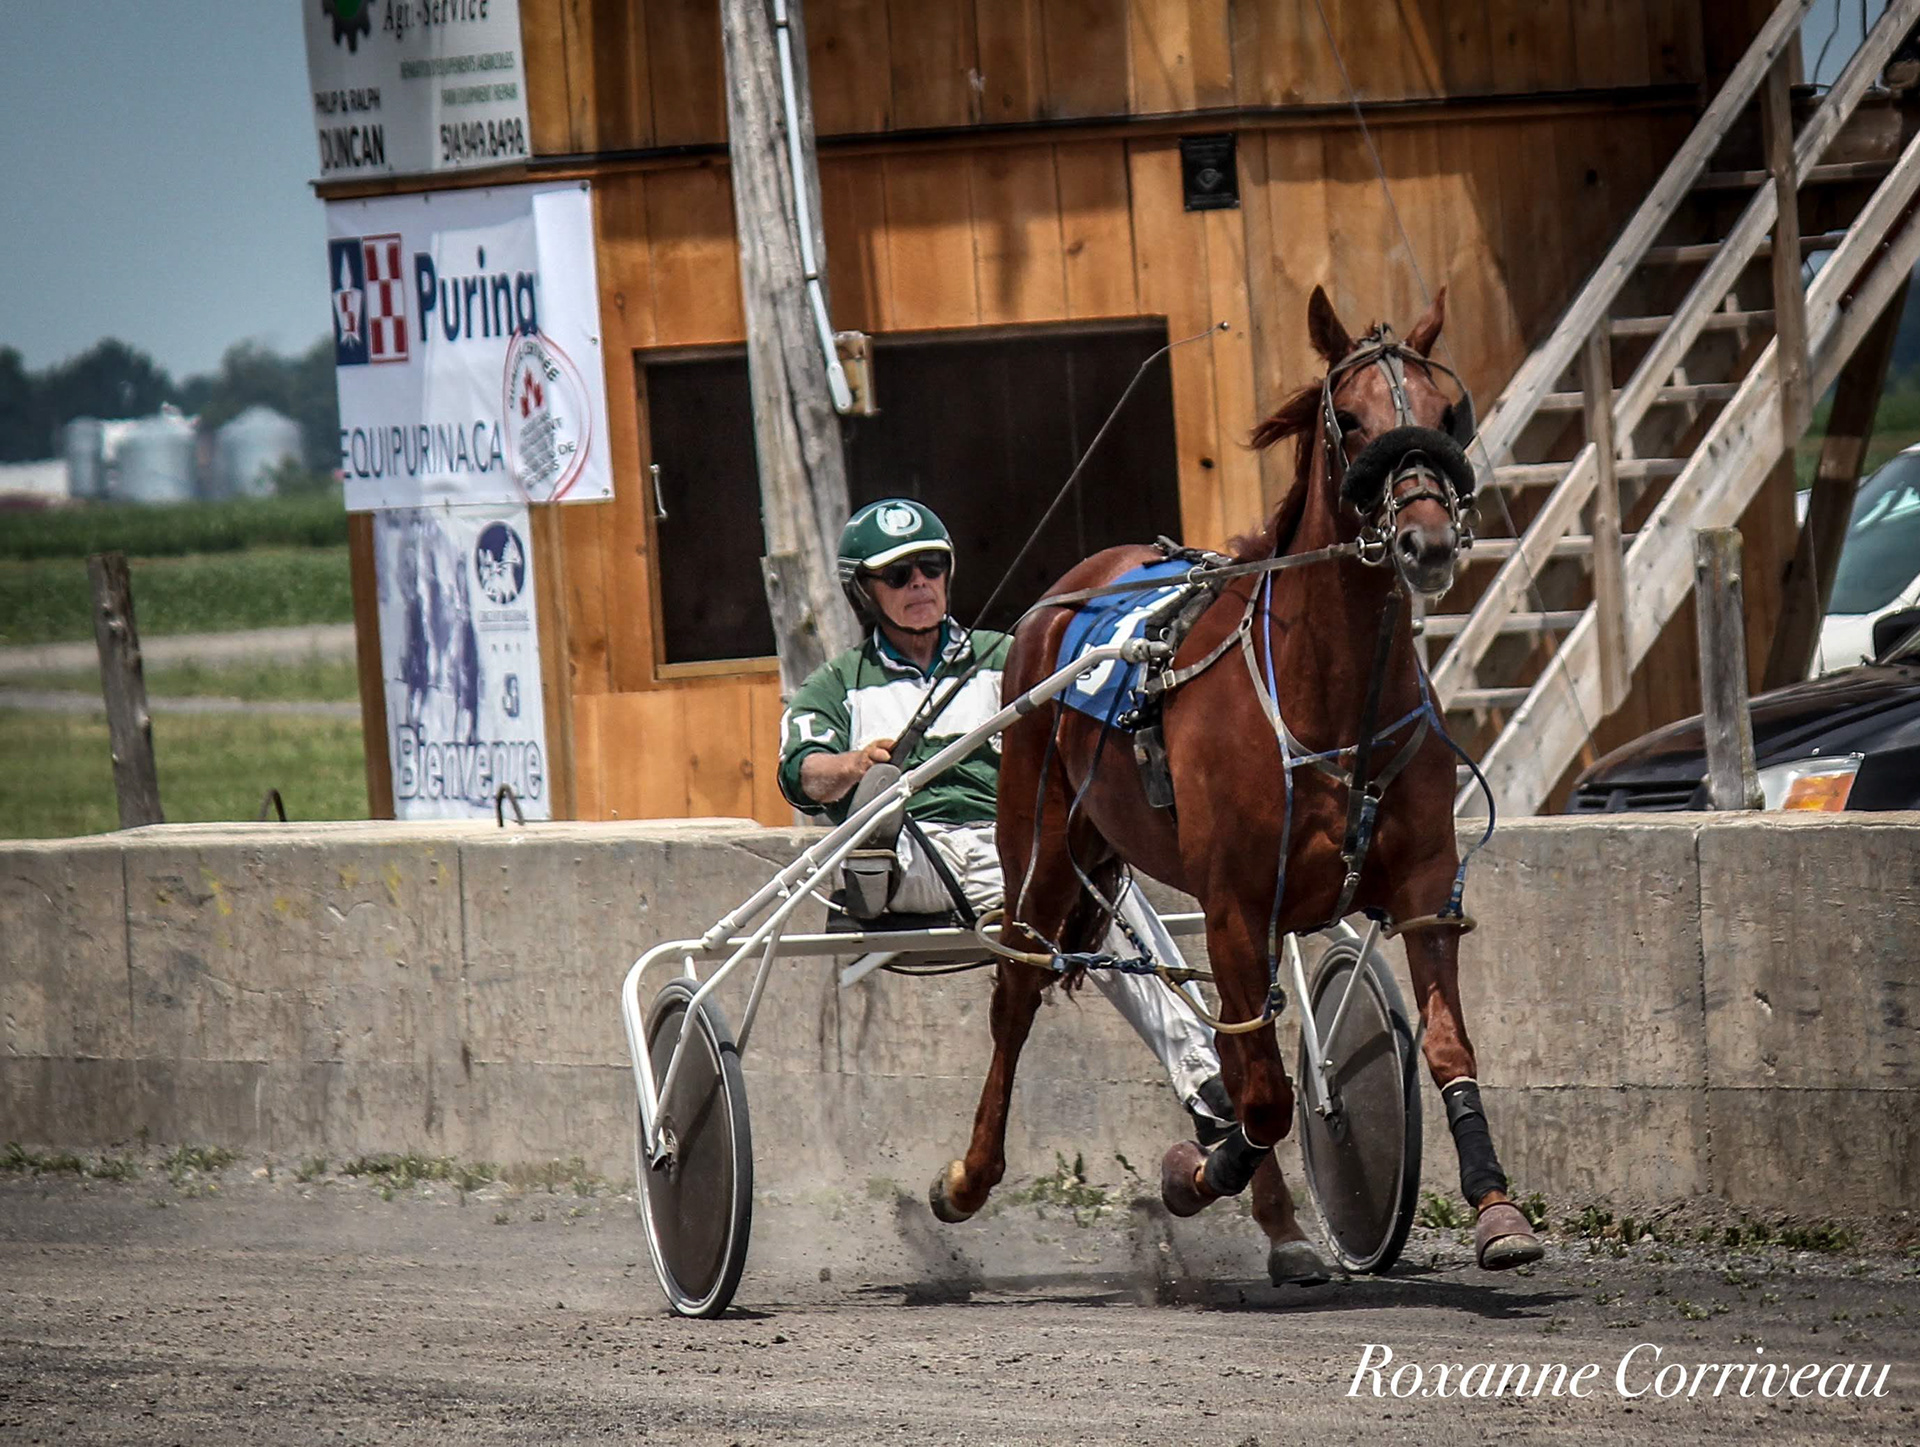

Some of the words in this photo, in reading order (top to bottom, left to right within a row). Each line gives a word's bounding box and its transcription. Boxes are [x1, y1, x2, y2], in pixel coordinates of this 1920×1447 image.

[318, 123, 385, 169] DUNCAN
[414, 244, 539, 342] Purina
[395, 723, 543, 801] Bienvenue
